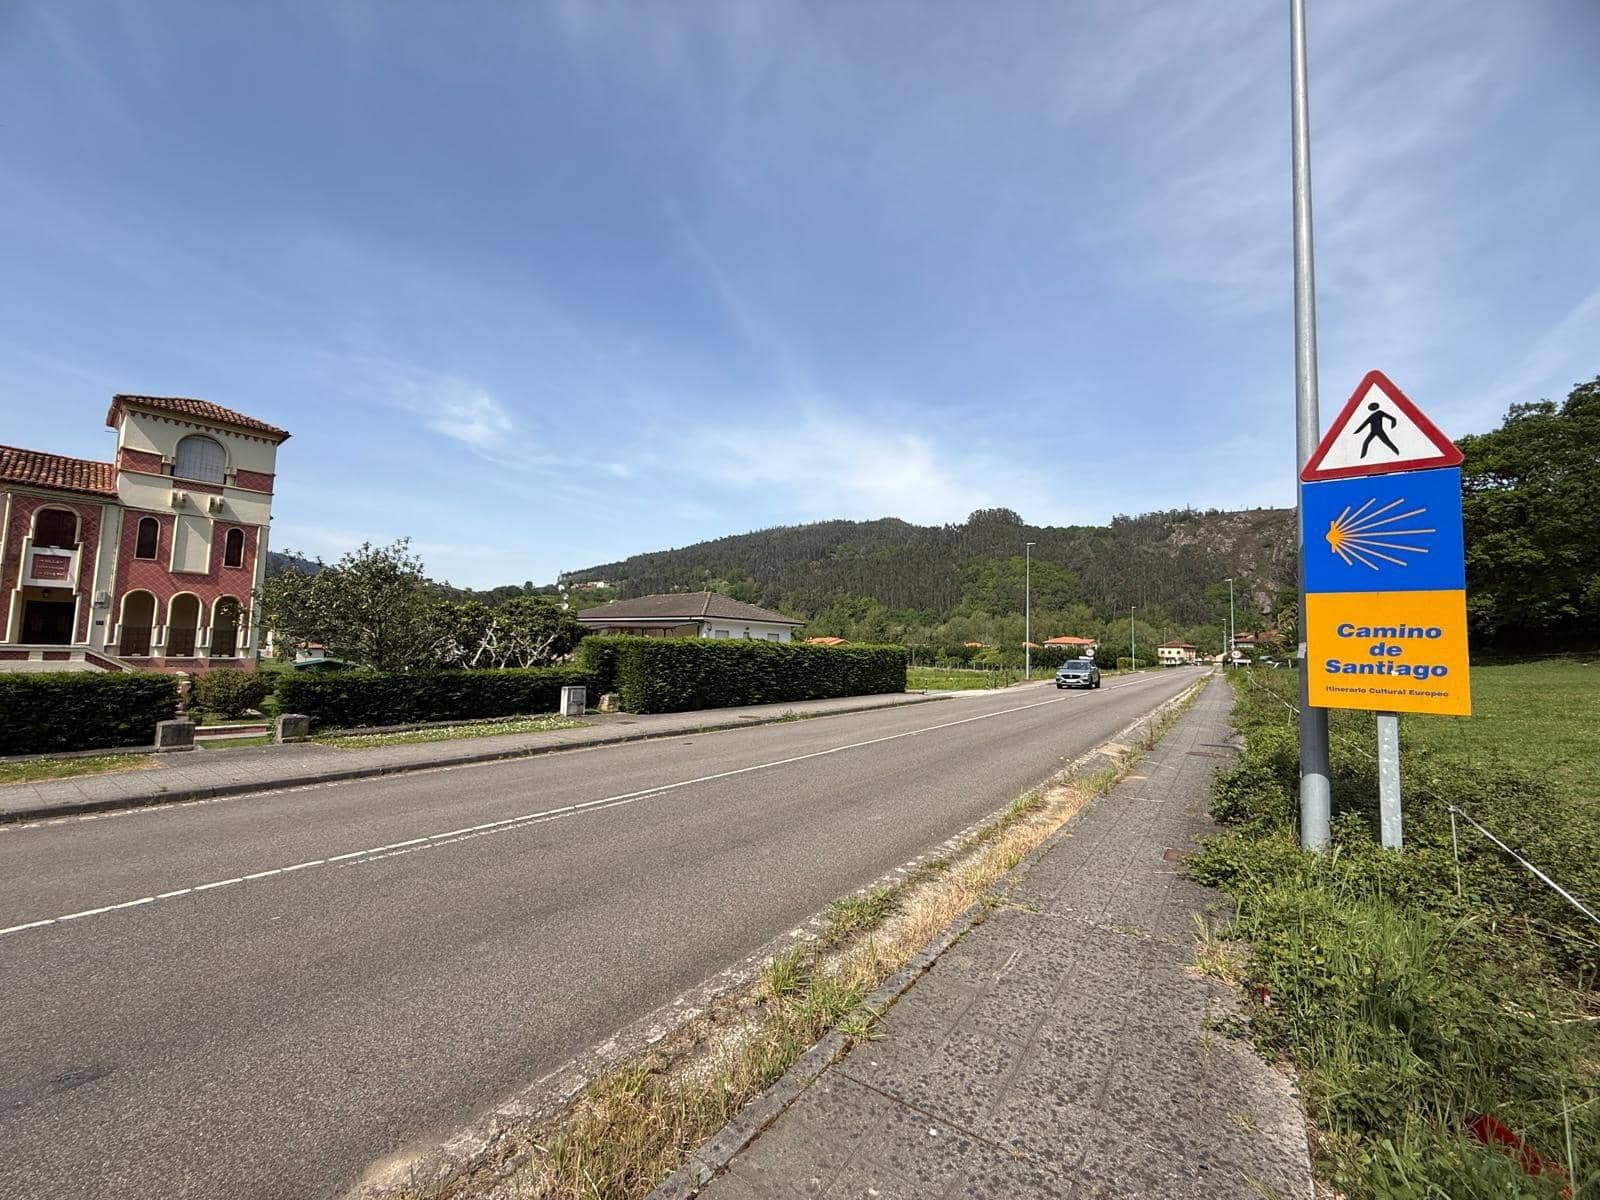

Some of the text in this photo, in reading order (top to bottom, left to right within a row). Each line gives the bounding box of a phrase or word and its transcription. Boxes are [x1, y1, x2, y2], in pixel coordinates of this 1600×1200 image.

[1337, 623, 1442, 639] Camino
[1369, 642, 1403, 657] de
[1325, 659, 1448, 680] Santiago
[1326, 685, 1449, 698] Itinerario Cultural Europeo
